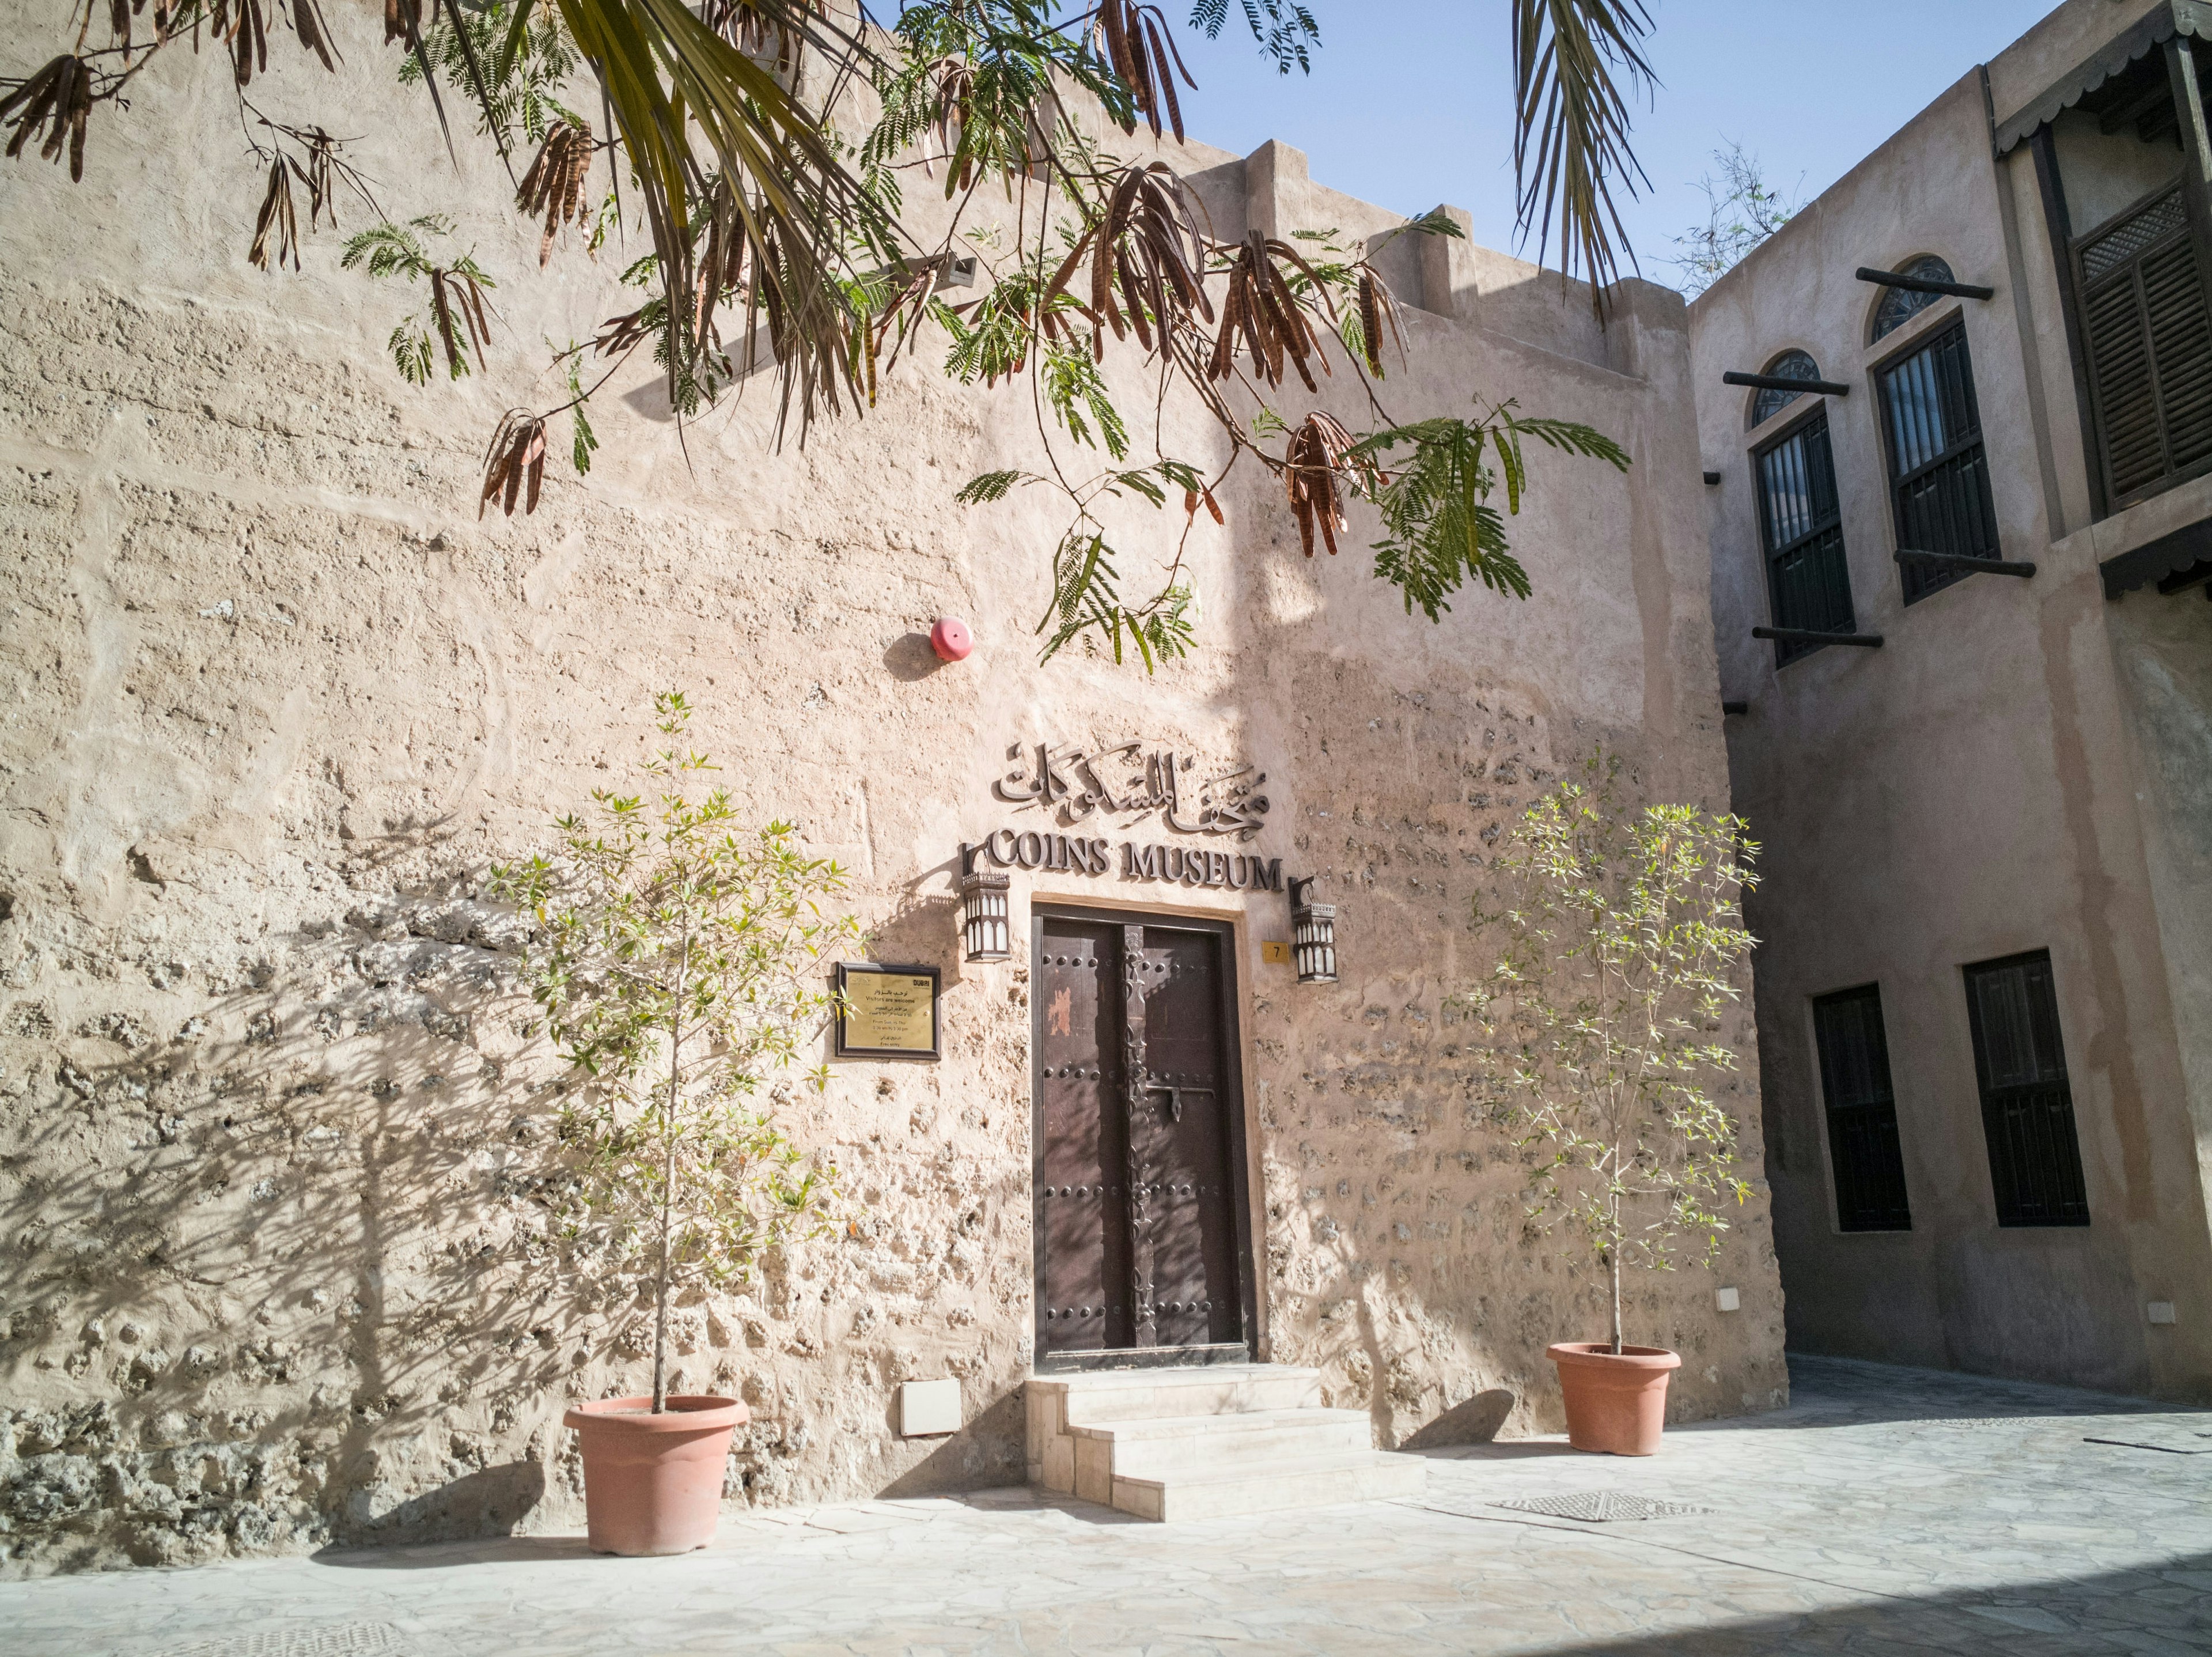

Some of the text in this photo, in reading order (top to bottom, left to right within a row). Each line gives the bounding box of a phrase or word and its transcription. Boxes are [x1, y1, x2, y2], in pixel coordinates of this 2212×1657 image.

[992, 827, 1285, 892] COINS MUSEUM
[1274, 947, 1279, 958] 7
